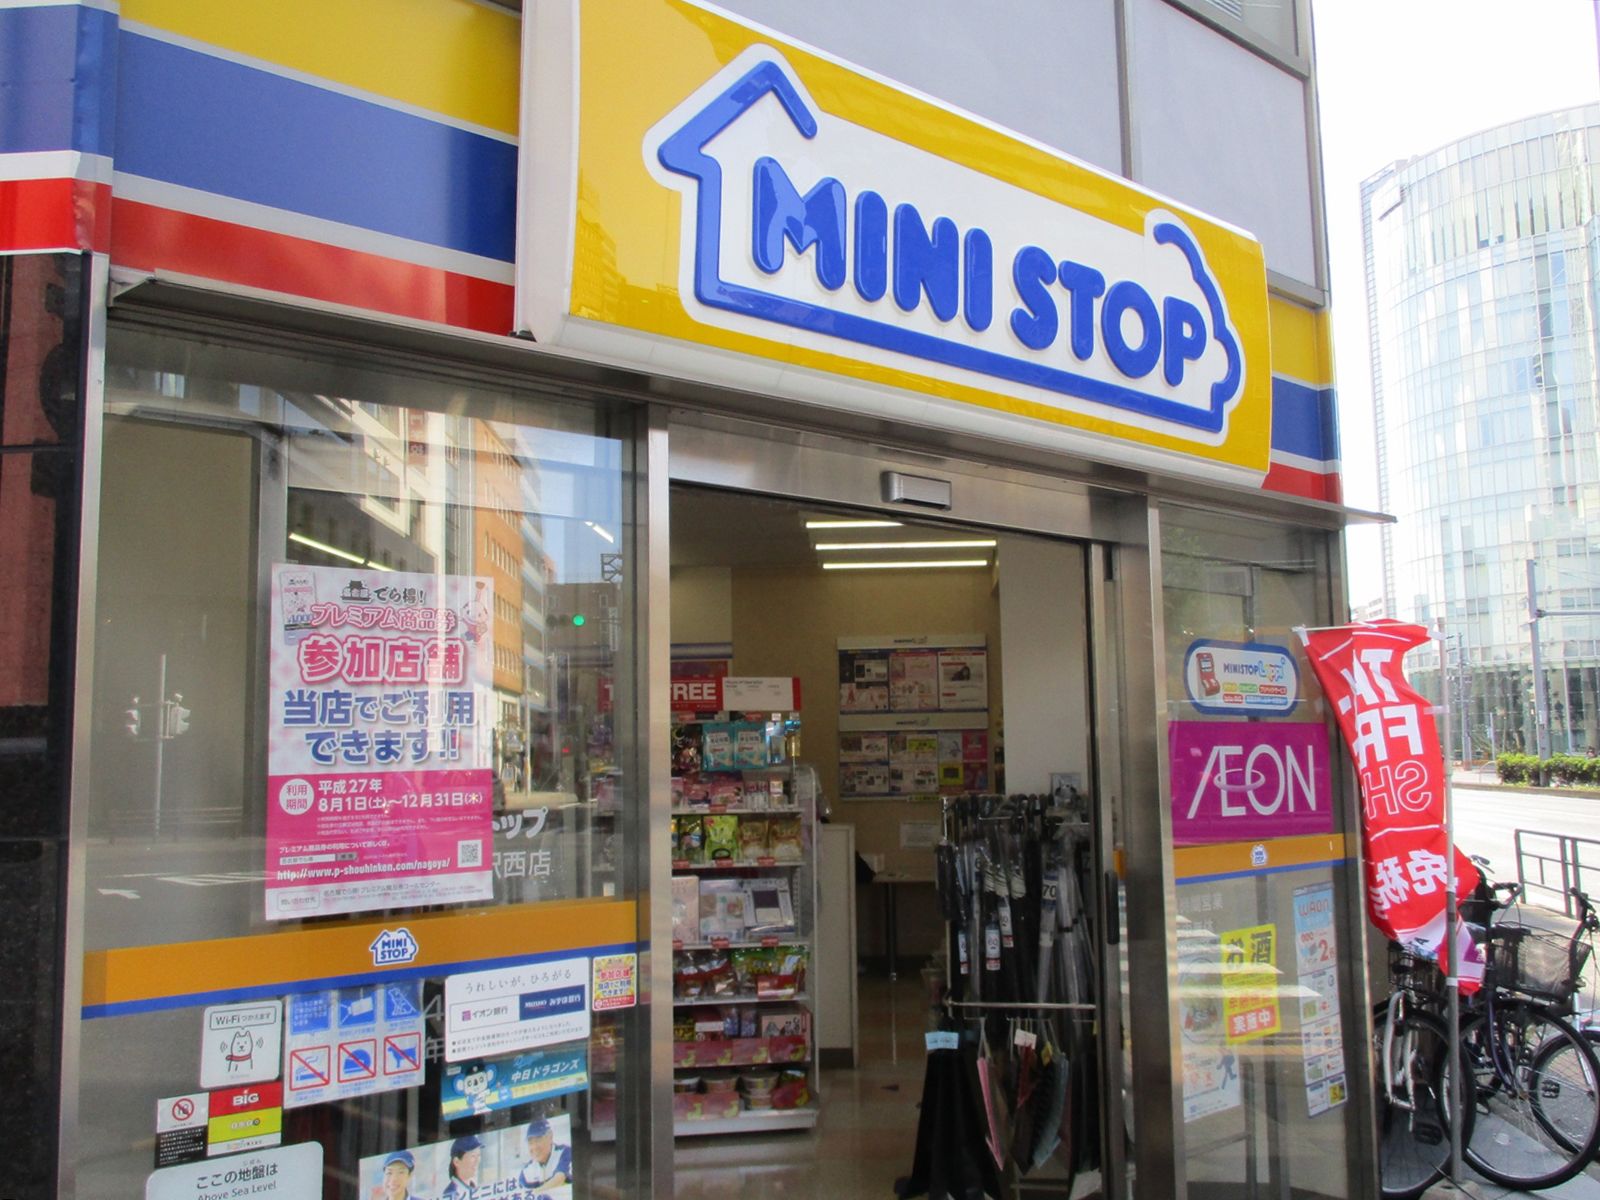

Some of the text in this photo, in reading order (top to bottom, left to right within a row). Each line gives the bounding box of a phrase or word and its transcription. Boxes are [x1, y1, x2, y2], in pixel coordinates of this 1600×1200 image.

[752, 157, 1207, 388] MINI STOP
[311, 603, 457, 632] プレミアム商品券
[299, 635, 466, 683] 参加店舗
[1223, 662, 1258, 676] MINISTOP
[671, 683, 716, 700] REE
[283, 690, 476, 727] 当店でご利用
[305, 729, 460, 764] できます!!
[286, 784, 308, 796] 利用
[318, 779, 383, 795] 平成27年
[286, 798, 308, 810] 期間
[381, 938, 407, 949] MINI
[380, 948, 408, 960] STOP
[465, 969, 572, 994] うれしいが、ひろがる
[215, 1015, 240, 1025] Wi-Fi
[472, 1005, 509, 1019] イオン銀行
[511, 1058, 581, 1083] 中日ドラゴンズ
[196, 1163, 279, 1190] ここの地盤は
[231, 1185, 251, 1197] Sea
[252, 1180, 277, 1193] Level
